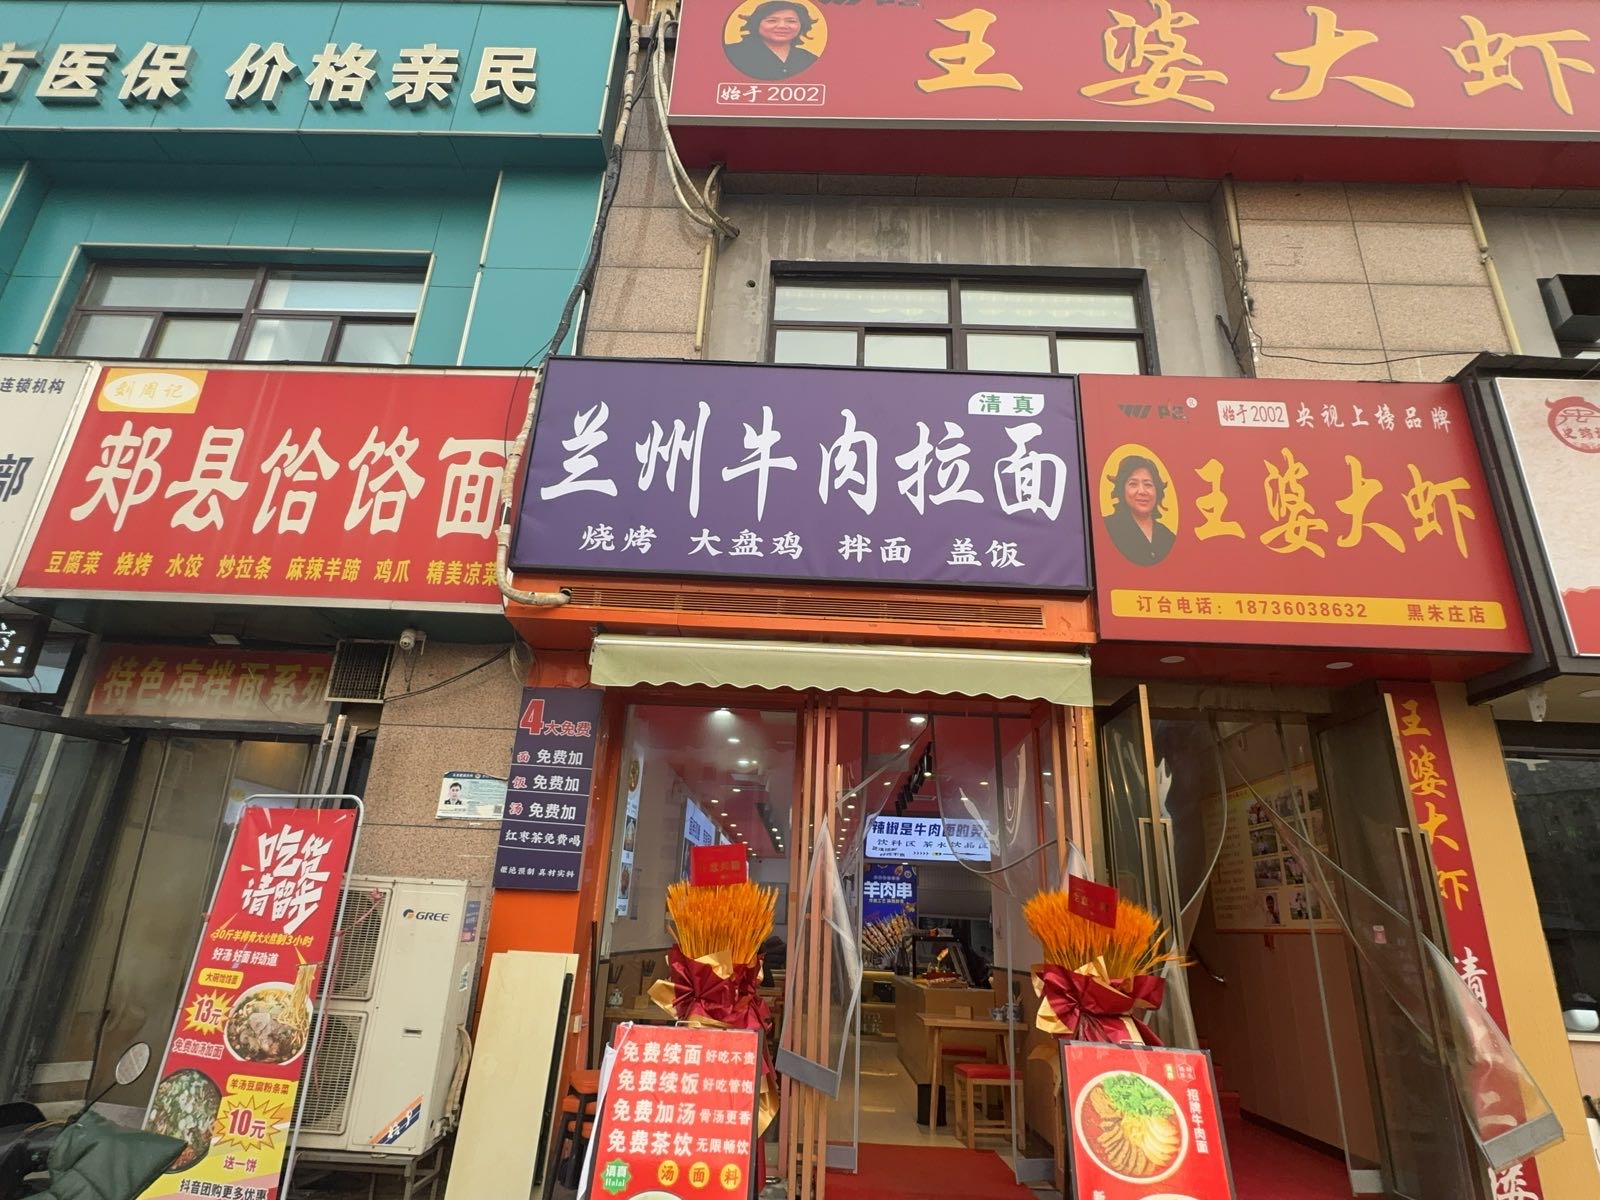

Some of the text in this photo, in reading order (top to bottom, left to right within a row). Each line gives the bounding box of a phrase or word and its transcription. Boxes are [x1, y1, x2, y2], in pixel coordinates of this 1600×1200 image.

[917, 0, 1595, 115] 王婆大虾
[225, 42, 539, 104] 价格亲民
[721, 85, 819, 102] 始于 2002
[0, 377, 65, 394] 连锁机构
[979, 394, 1035, 414] 清真
[1223, 401, 1452, 432] 始于 2002 央视上榜品牌
[540, 400, 1068, 522] 兰州牛肉拉面
[69, 420, 515, 539] 郏县饸饹面
[1194, 447, 1476, 559] 王婆大虾
[581, 524, 1026, 569] 烧烤 大盘鸡 拌面 盖饭
[44, 550, 498, 586] 豆腐菜 烧烤 水饺 炒拉条 麻辣羊蹄 鸡爪 精美凉菜
[1235, 599, 1368, 618] 18736038632
[1406, 603, 1487, 624] 黑朱庄店
[519, 699, 592, 738] 4大免费
[536, 749, 584, 766] 免费加
[533, 774, 580, 792] 免费加
[528, 802, 577, 820] 免费加
[504, 829, 582, 848] 红枣茶免费喝
[257, 824, 334, 882] 吃货
[863, 880, 913, 899] 羊肉串
[241, 873, 324, 936] 请留步
[415, 911, 450, 922] GREE
[193, 999, 223, 1027] 13元
[621, 1042, 703, 1066] 免费续面
[616, 1068, 754, 1095] 免费续饭 好吃管饱
[229, 1109, 267, 1140] 10元
[612, 1098, 752, 1126] 免费加汤 骨汤更香
[607, 1128, 750, 1157] 免费茶饮 无限畅饮
[223, 1156, 258, 1173] 送一饼
[661, 1165, 739, 1186] 汤 面 料
[180, 1178, 268, 1200] 抖音团购更多优惠
